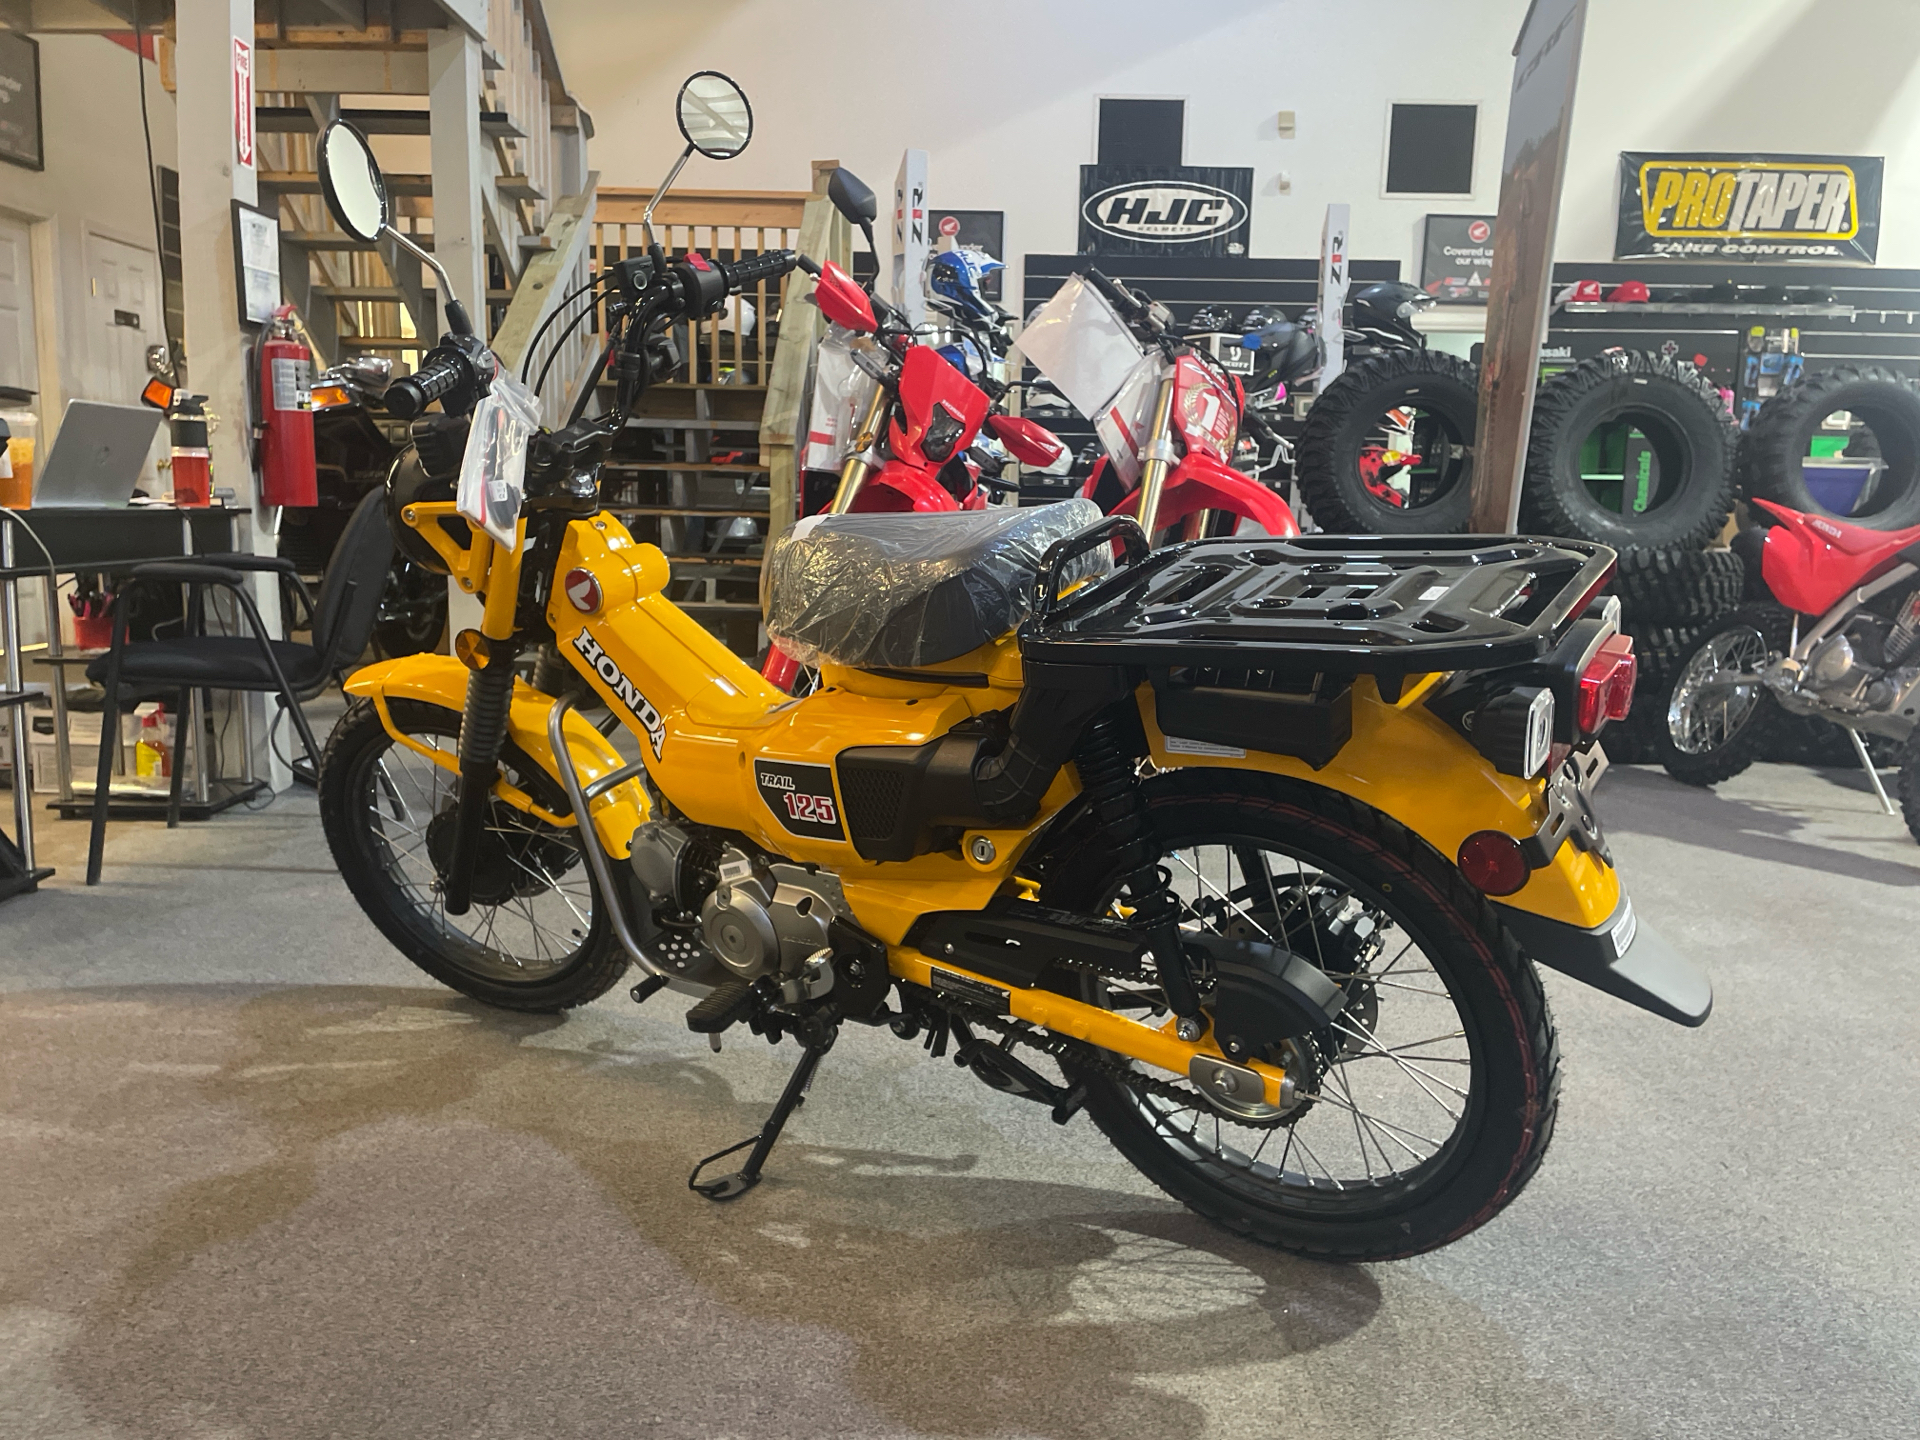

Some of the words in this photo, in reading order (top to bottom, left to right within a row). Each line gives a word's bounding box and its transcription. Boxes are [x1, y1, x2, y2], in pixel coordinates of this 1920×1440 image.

[1106, 197, 1226, 225] HJC
[1650, 171, 1850, 233] PROTAPER
[1443, 246, 1484, 256] Covered
[1652, 242, 1718, 254] TAKE
[1719, 244, 1841, 256] CONTROL
[1455, 257, 1472, 265] our
[572, 625, 667, 763] HONDA
[760, 772, 796, 791] TRAIL
[783, 791, 837, 825] 125
